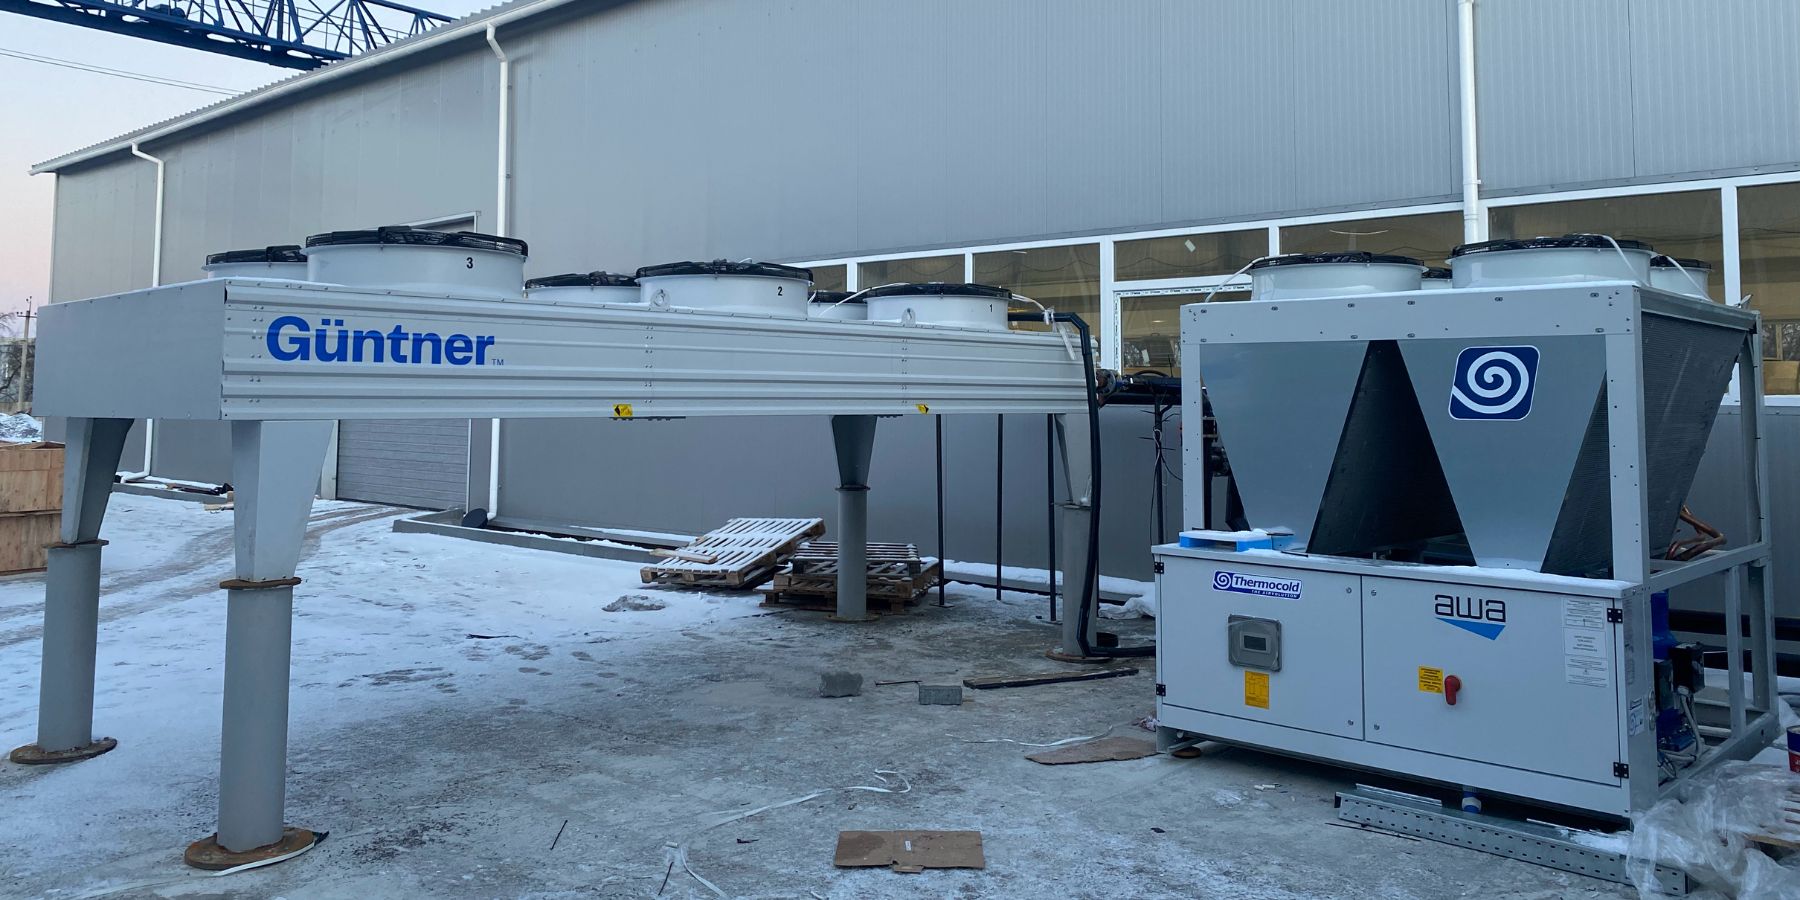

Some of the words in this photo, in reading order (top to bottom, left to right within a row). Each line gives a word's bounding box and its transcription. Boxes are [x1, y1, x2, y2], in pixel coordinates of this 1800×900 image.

[466, 257, 474, 269] 3
[777, 286, 783, 297] 2
[989, 303, 993, 313] 1
[266, 315, 495, 366] Güntner
[491, 358, 504, 366] TM
[1234, 576, 1300, 592] Thermocold
[1435, 594, 1506, 622] awa
